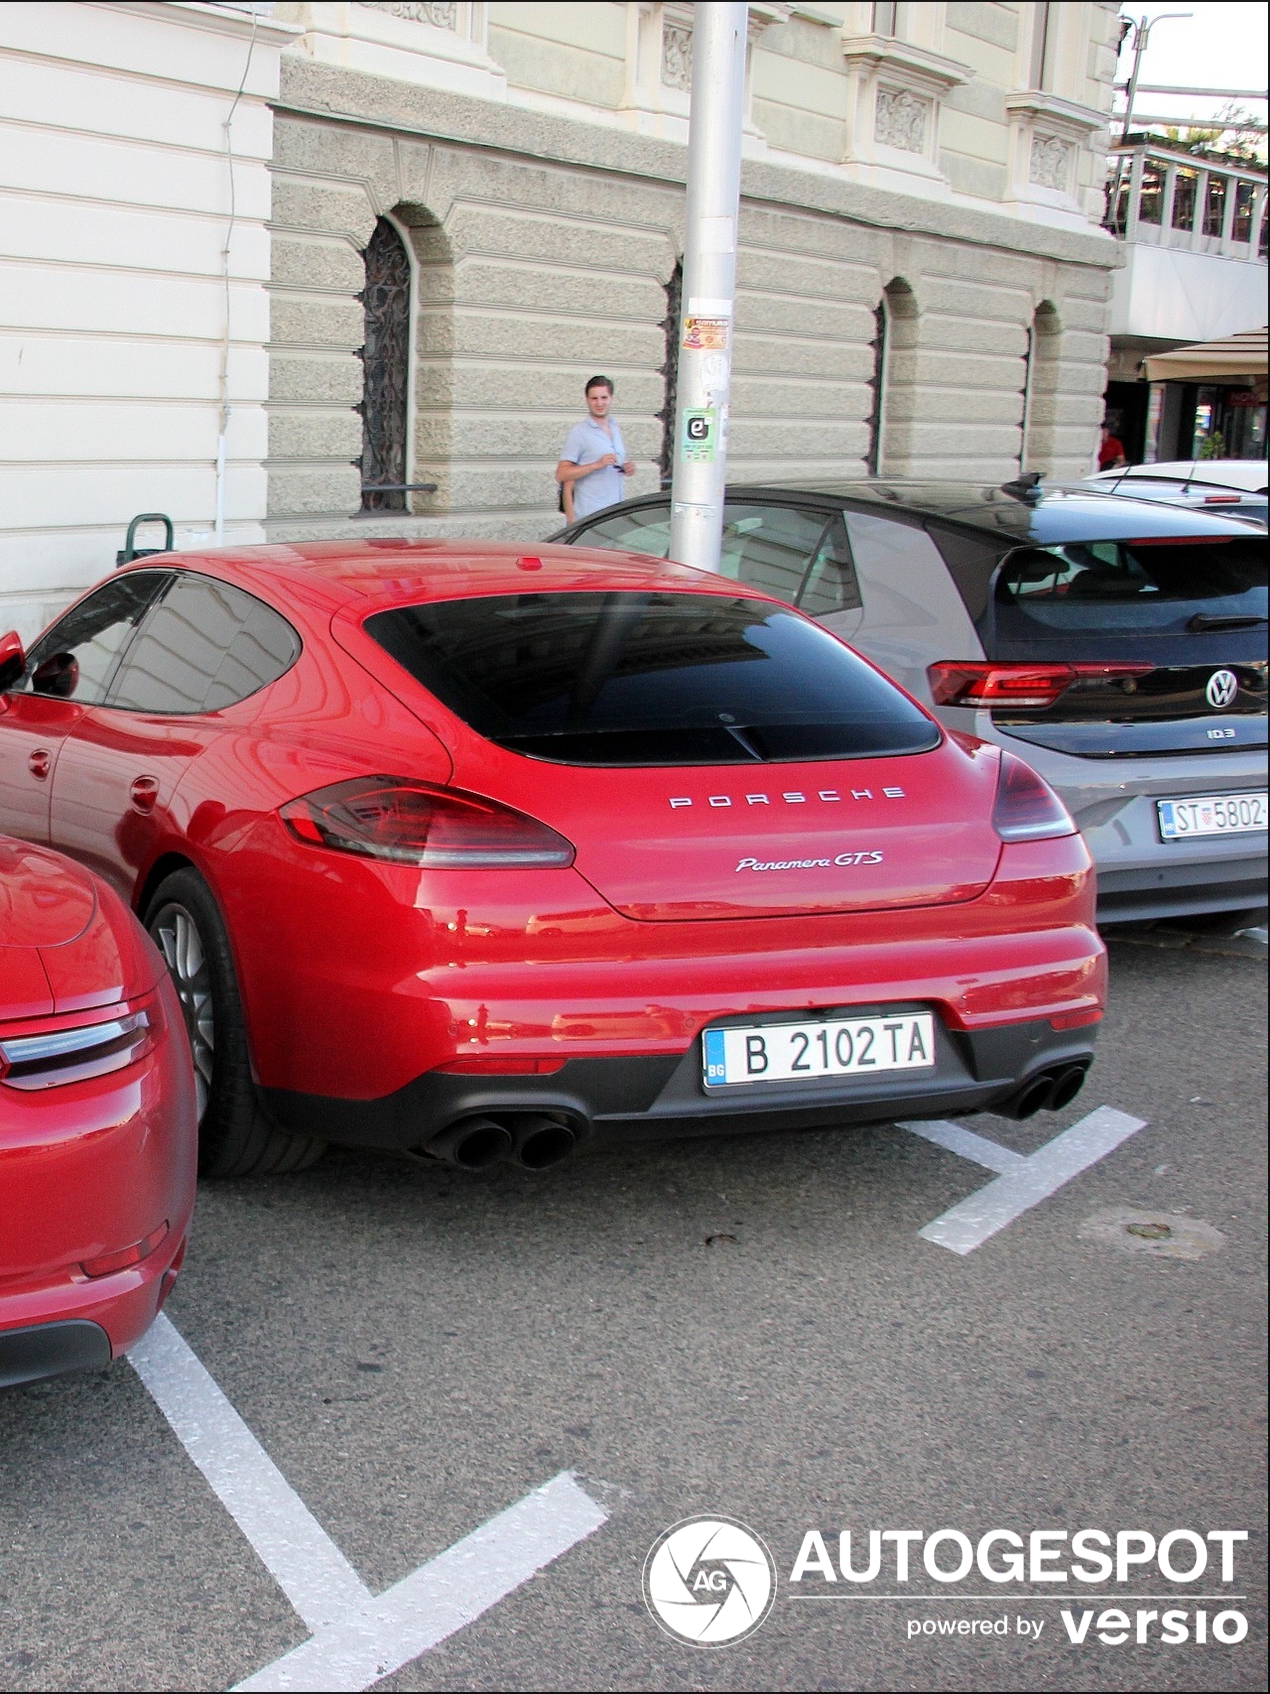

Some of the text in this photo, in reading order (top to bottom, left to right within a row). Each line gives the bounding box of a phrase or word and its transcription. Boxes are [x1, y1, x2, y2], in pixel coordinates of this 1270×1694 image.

[669, 787, 905, 809] PORSCHE
[1176, 804, 1199, 831] ST
[735, 850, 883, 872] Panamera GTS
[745, 1022, 927, 1074] B 2102 TA
[708, 1064, 724, 1077] BG
